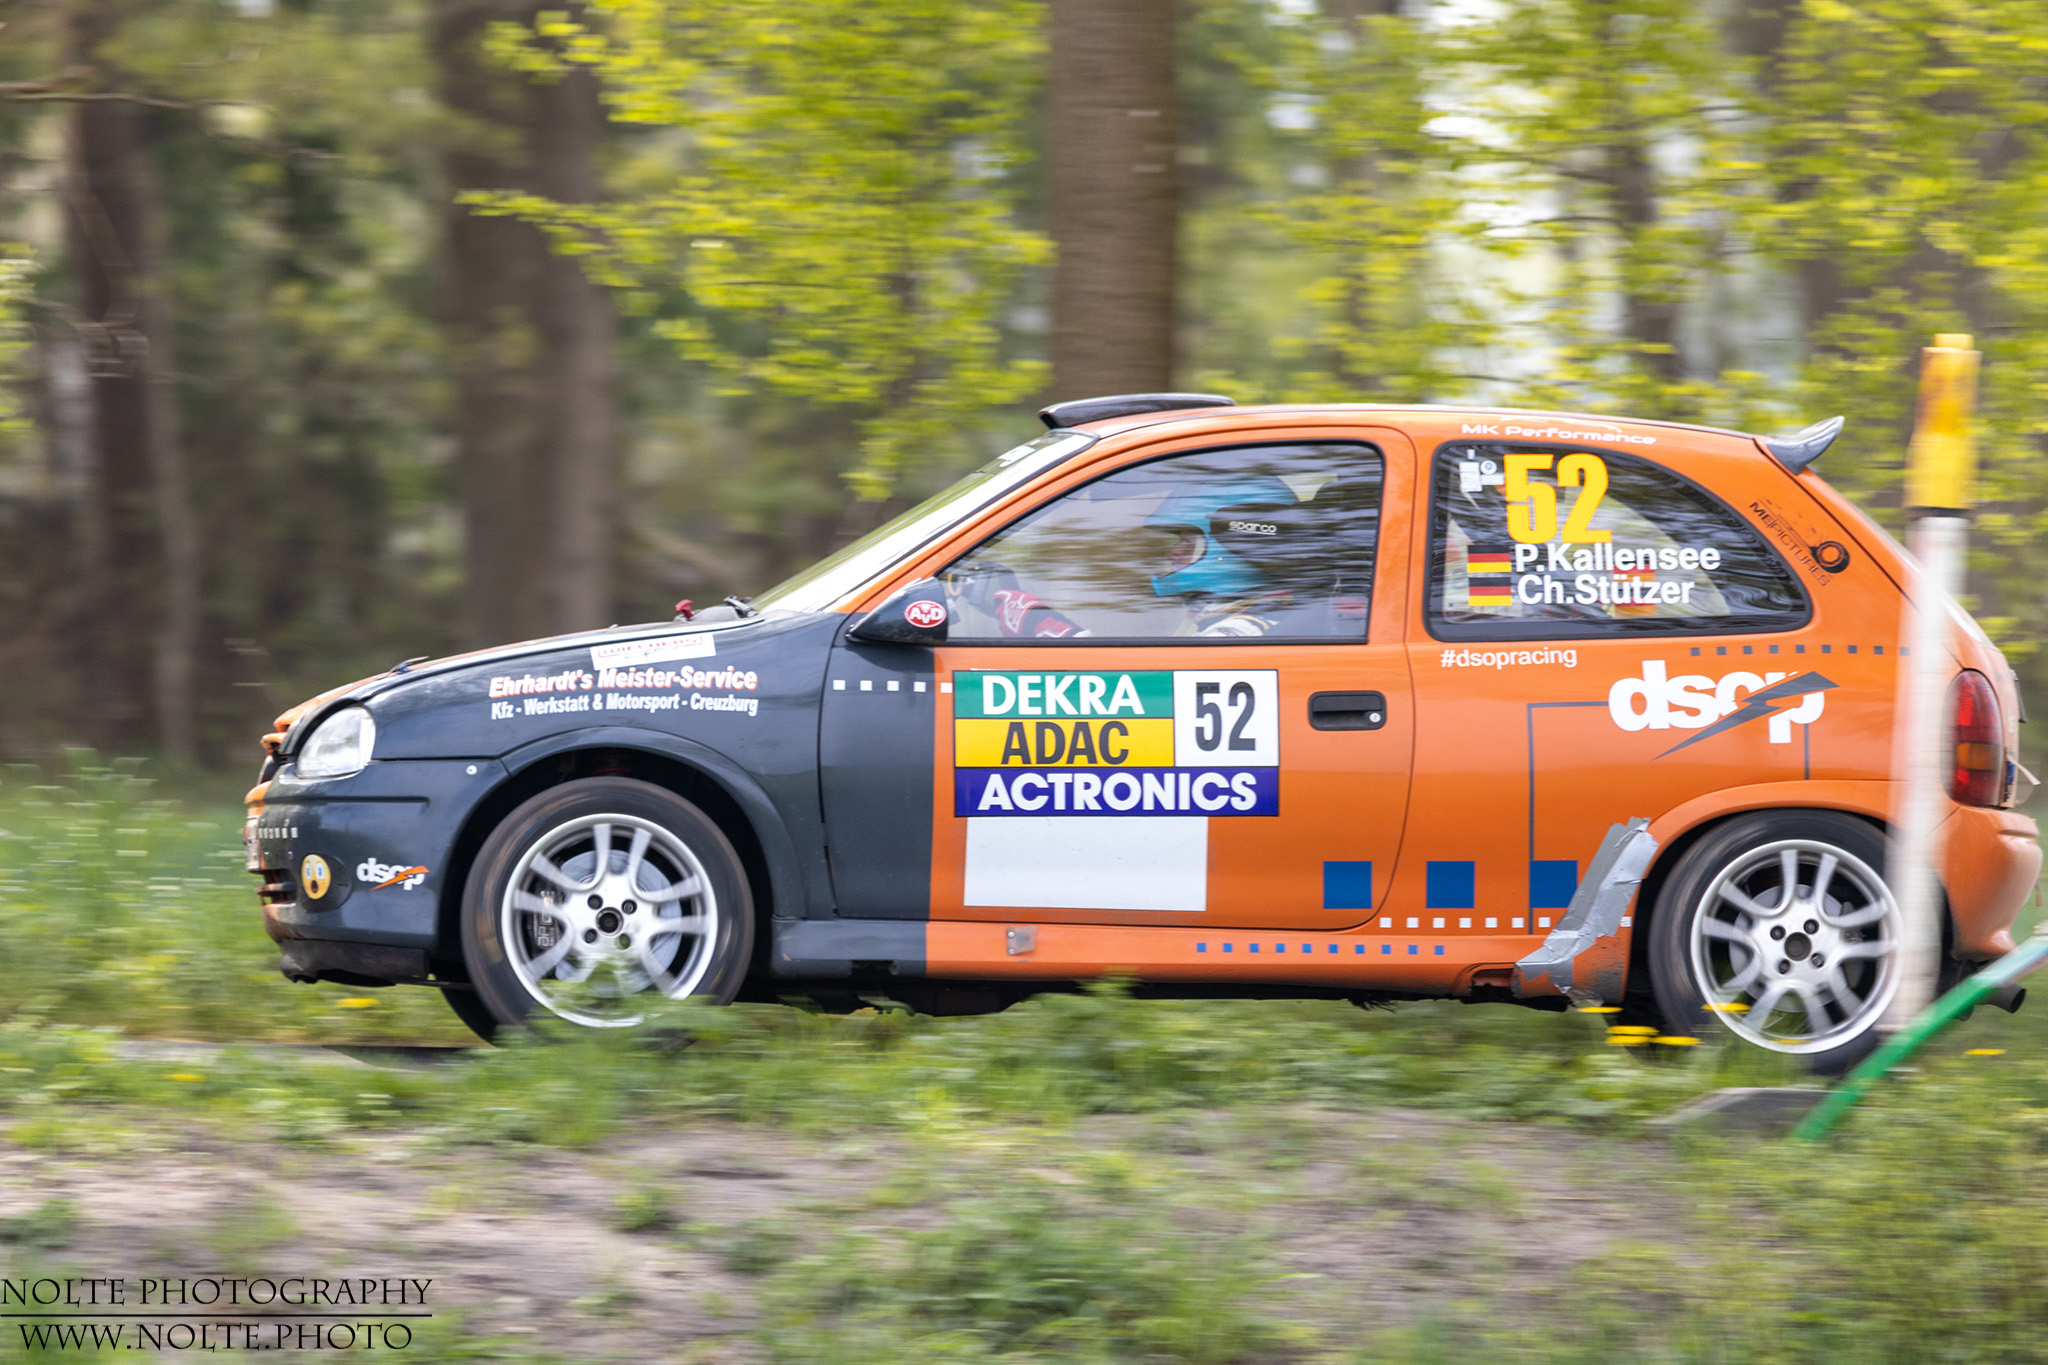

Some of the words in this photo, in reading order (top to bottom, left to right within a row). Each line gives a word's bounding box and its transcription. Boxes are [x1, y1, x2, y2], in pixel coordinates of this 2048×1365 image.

[1461, 424, 1499, 435] MK
[1505, 425, 1657, 445] Performance
[1502, 452, 1613, 545] 52
[1228, 520, 1278, 534] sparco
[1514, 543, 1722, 573] P.Kallensee
[1517, 574, 1696, 605] Ch.Stützer
[1439, 646, 1578, 670] #dsopracing
[489, 669, 594, 699] Ehrhardt's
[597, 665, 758, 691] Meister-Service
[982, 674, 1145, 715] DEKRA
[491, 701, 515, 720] Kfz
[523, 695, 590, 716] Werkstatt
[592, 693, 603, 711] &
[605, 692, 680, 713] Motorsport
[690, 692, 759, 717] Creuzburg
[1194, 681, 1257, 752] 52
[1608, 660, 1825, 744] dsop
[1000, 720, 1129, 765] ADAC
[977, 772, 1258, 811] ACTRONICS
